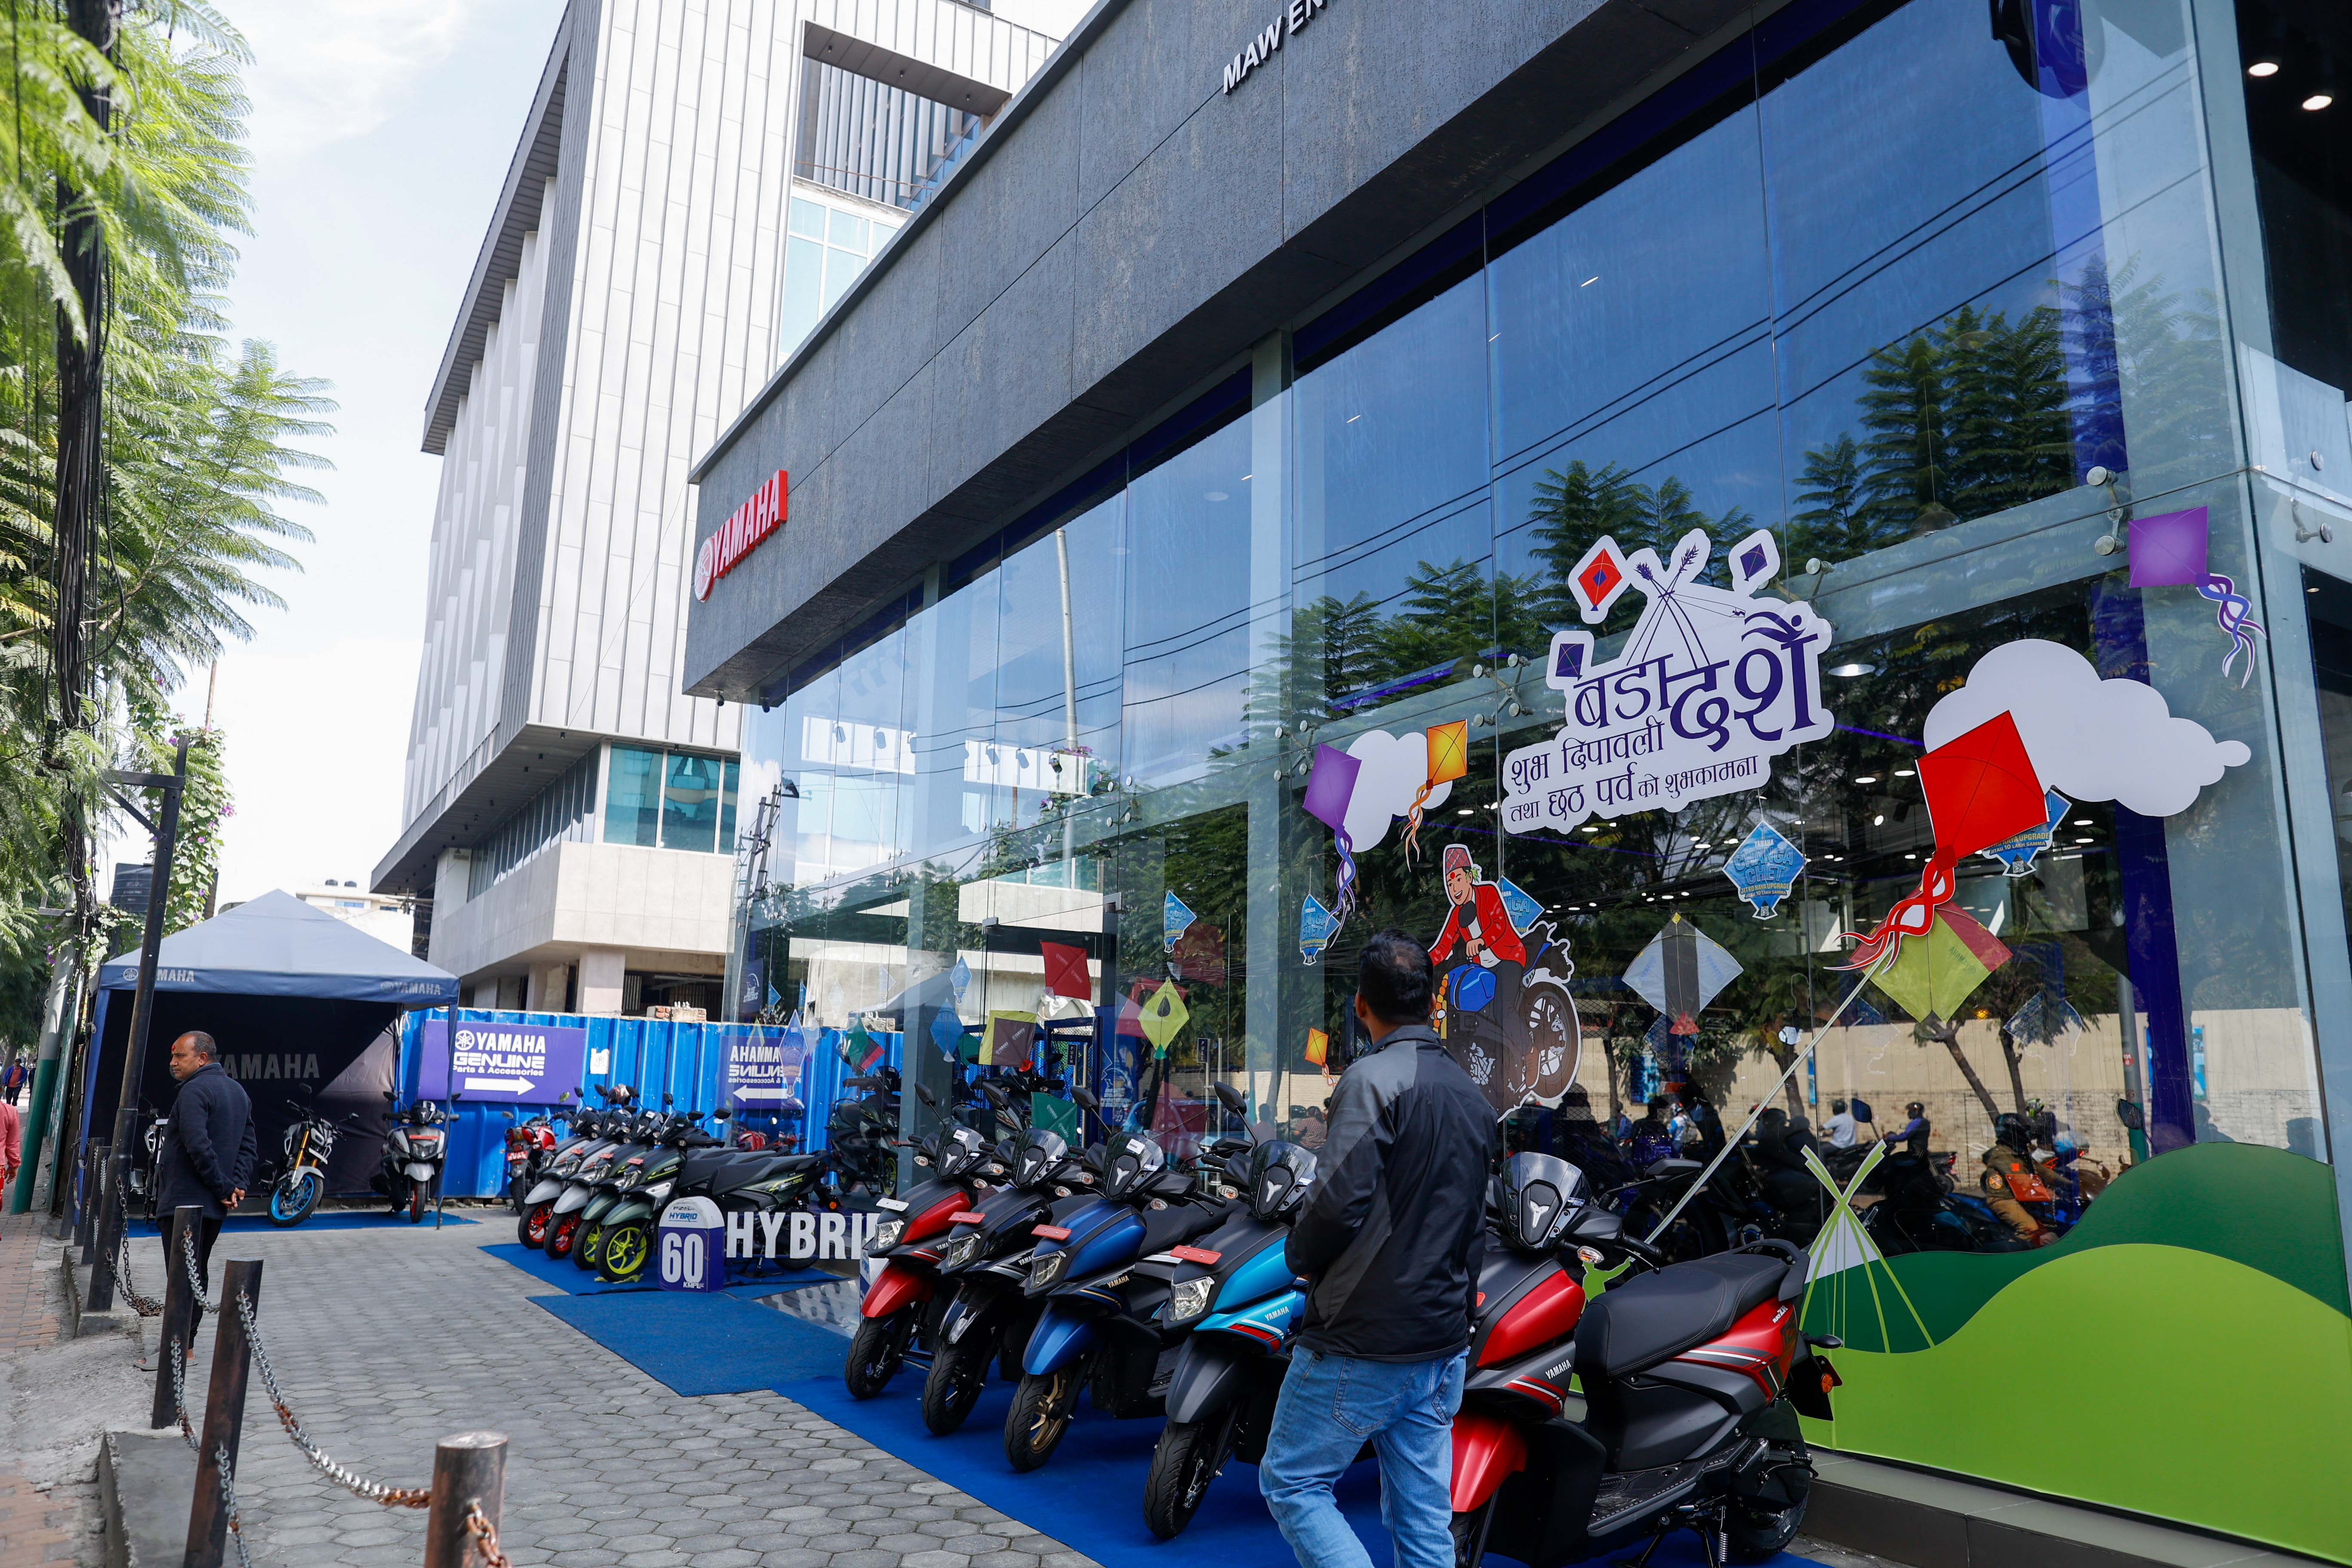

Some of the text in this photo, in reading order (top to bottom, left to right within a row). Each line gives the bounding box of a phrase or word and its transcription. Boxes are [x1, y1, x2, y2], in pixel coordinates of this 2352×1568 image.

[1223, 15, 1286, 95] MAW
[714, 469, 787, 578] YAMAHA
[1511, 715, 1665, 794] शुभ दिपावली
[1510, 755, 1758, 822] तथा छठ पर्व को शुभकामना
[2019, 833, 2049, 841] UPGRADE
[1734, 847, 1793, 871] CHANGA
[1745, 864, 1785, 885] CHET
[1504, 897, 1531, 913] NGA
[157, 969, 194, 982] MAHA
[395, 982, 441, 995] YAMAHA
[477, 1032, 545, 1054] YAMAHA
[215, 1054, 319, 1079] AMAHA
[454, 1052, 545, 1069] GENUINE
[488, 1067, 544, 1076] Accessories
[669, 1213, 698, 1222] HYBRID
[936, 1243, 949, 1251] YAMA
[662, 1232, 704, 1283] 60
[1018, 1256, 1032, 1266] YAMA
[1107, 1275, 1129, 1289] YAMAHA
[1265, 1306, 1289, 1322] YAMAHA
[1545, 1359, 1571, 1380] YAMAHA
